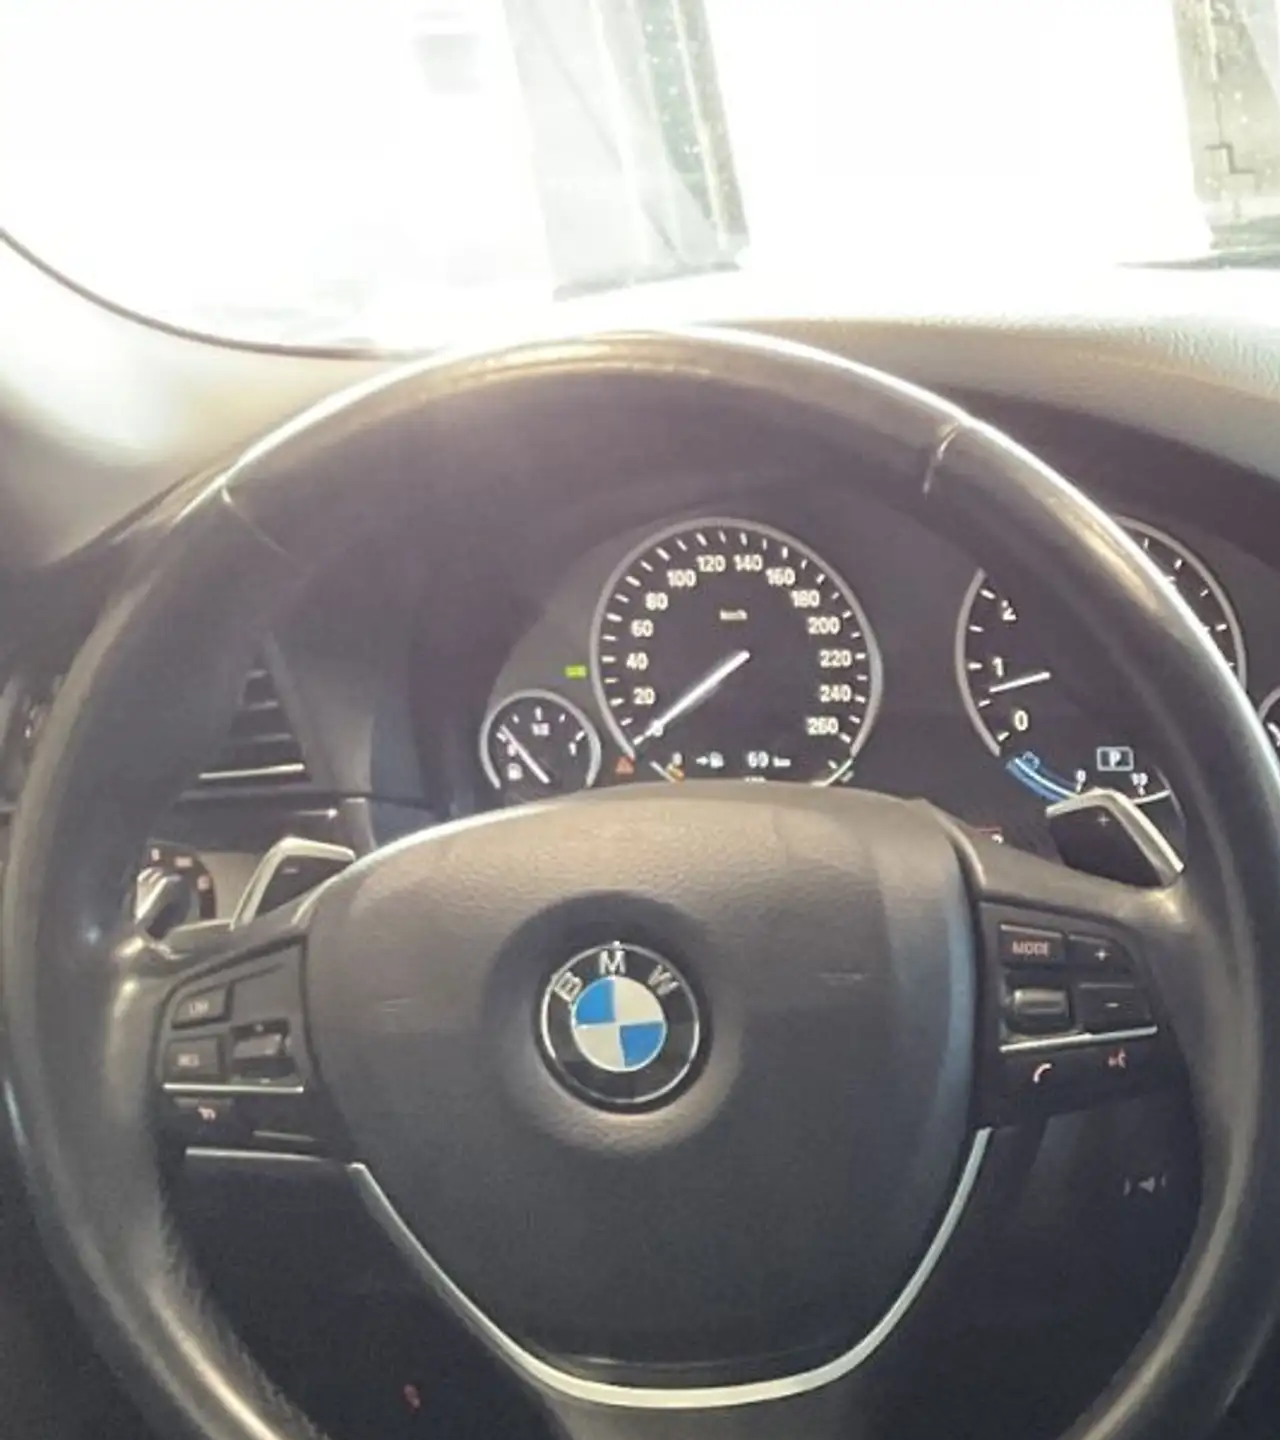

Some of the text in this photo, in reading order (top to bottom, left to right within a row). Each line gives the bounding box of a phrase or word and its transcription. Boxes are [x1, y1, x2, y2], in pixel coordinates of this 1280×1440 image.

[697, 555, 726, 573] 120
[733, 554, 764, 573] 140
[667, 568, 697, 588] 100
[765, 567, 796, 587] 160
[645, 592, 668, 612] 80
[791, 589, 820, 609] 180
[631, 619, 655, 639] 60
[808, 616, 841, 636] 200
[626, 652, 649, 672] 40
[819, 649, 853, 668] 220
[992, 656, 1004, 677] 1
[633, 687, 656, 707] 20
[819, 684, 852, 703] 240
[807, 718, 839, 736] 260
[1013, 709, 1029, 732] 0
[554, 949, 681, 1003] BMW
